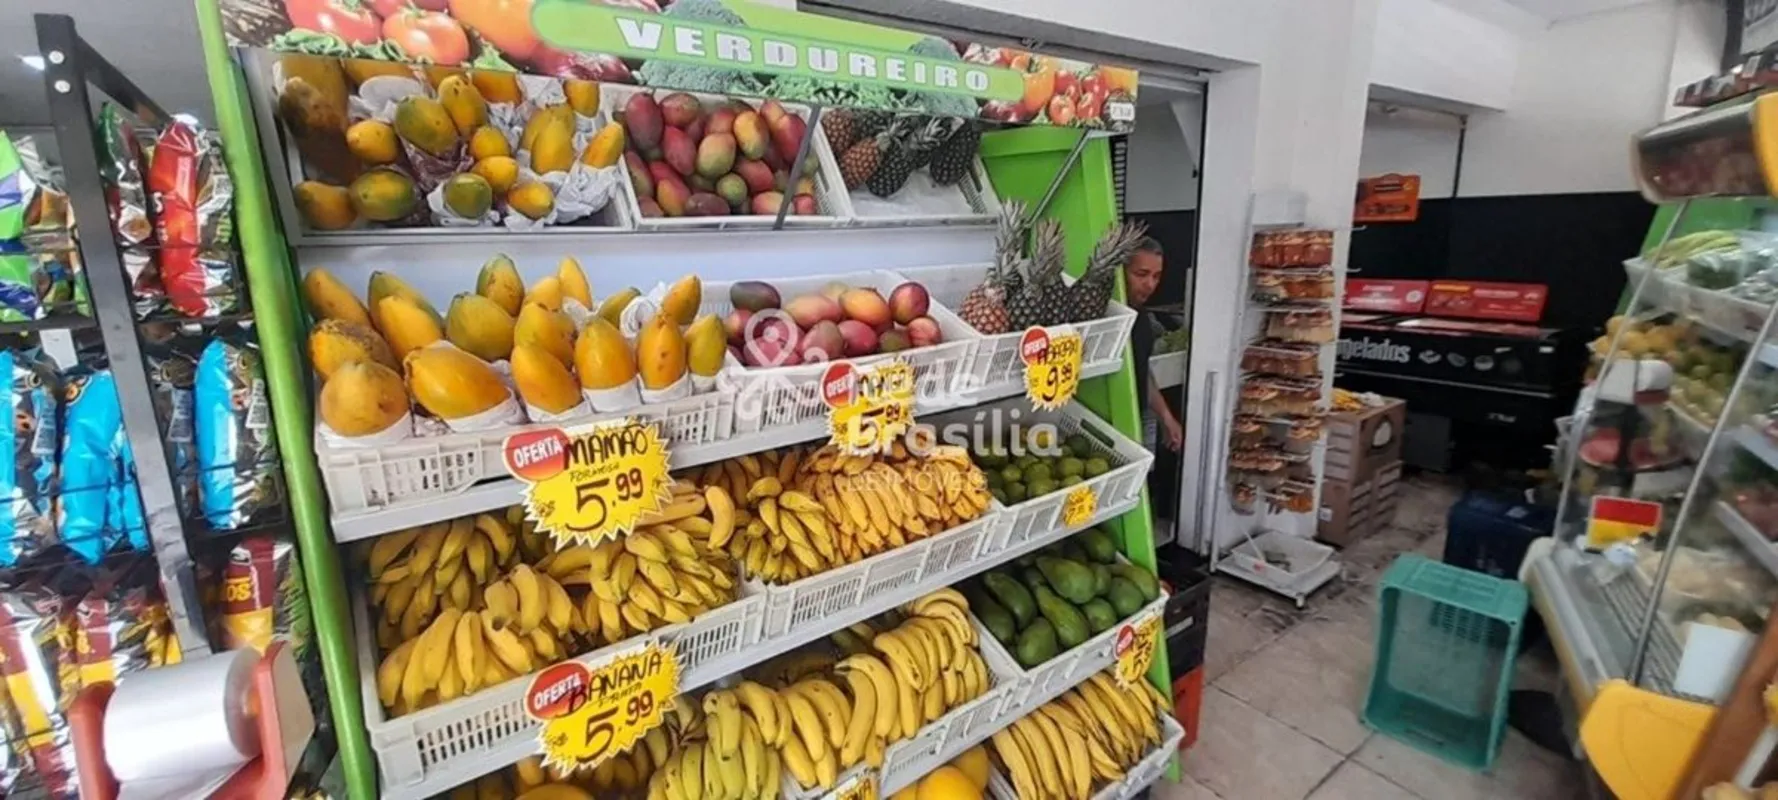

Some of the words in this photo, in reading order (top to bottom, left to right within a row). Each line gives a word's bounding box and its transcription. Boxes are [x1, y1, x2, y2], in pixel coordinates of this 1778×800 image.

[616, 17, 990, 92] VERDUREIRO
[513, 436, 564, 468] OFERTA
[563, 424, 648, 470] MAMÃO
[552, 651, 662, 718] BANANA
